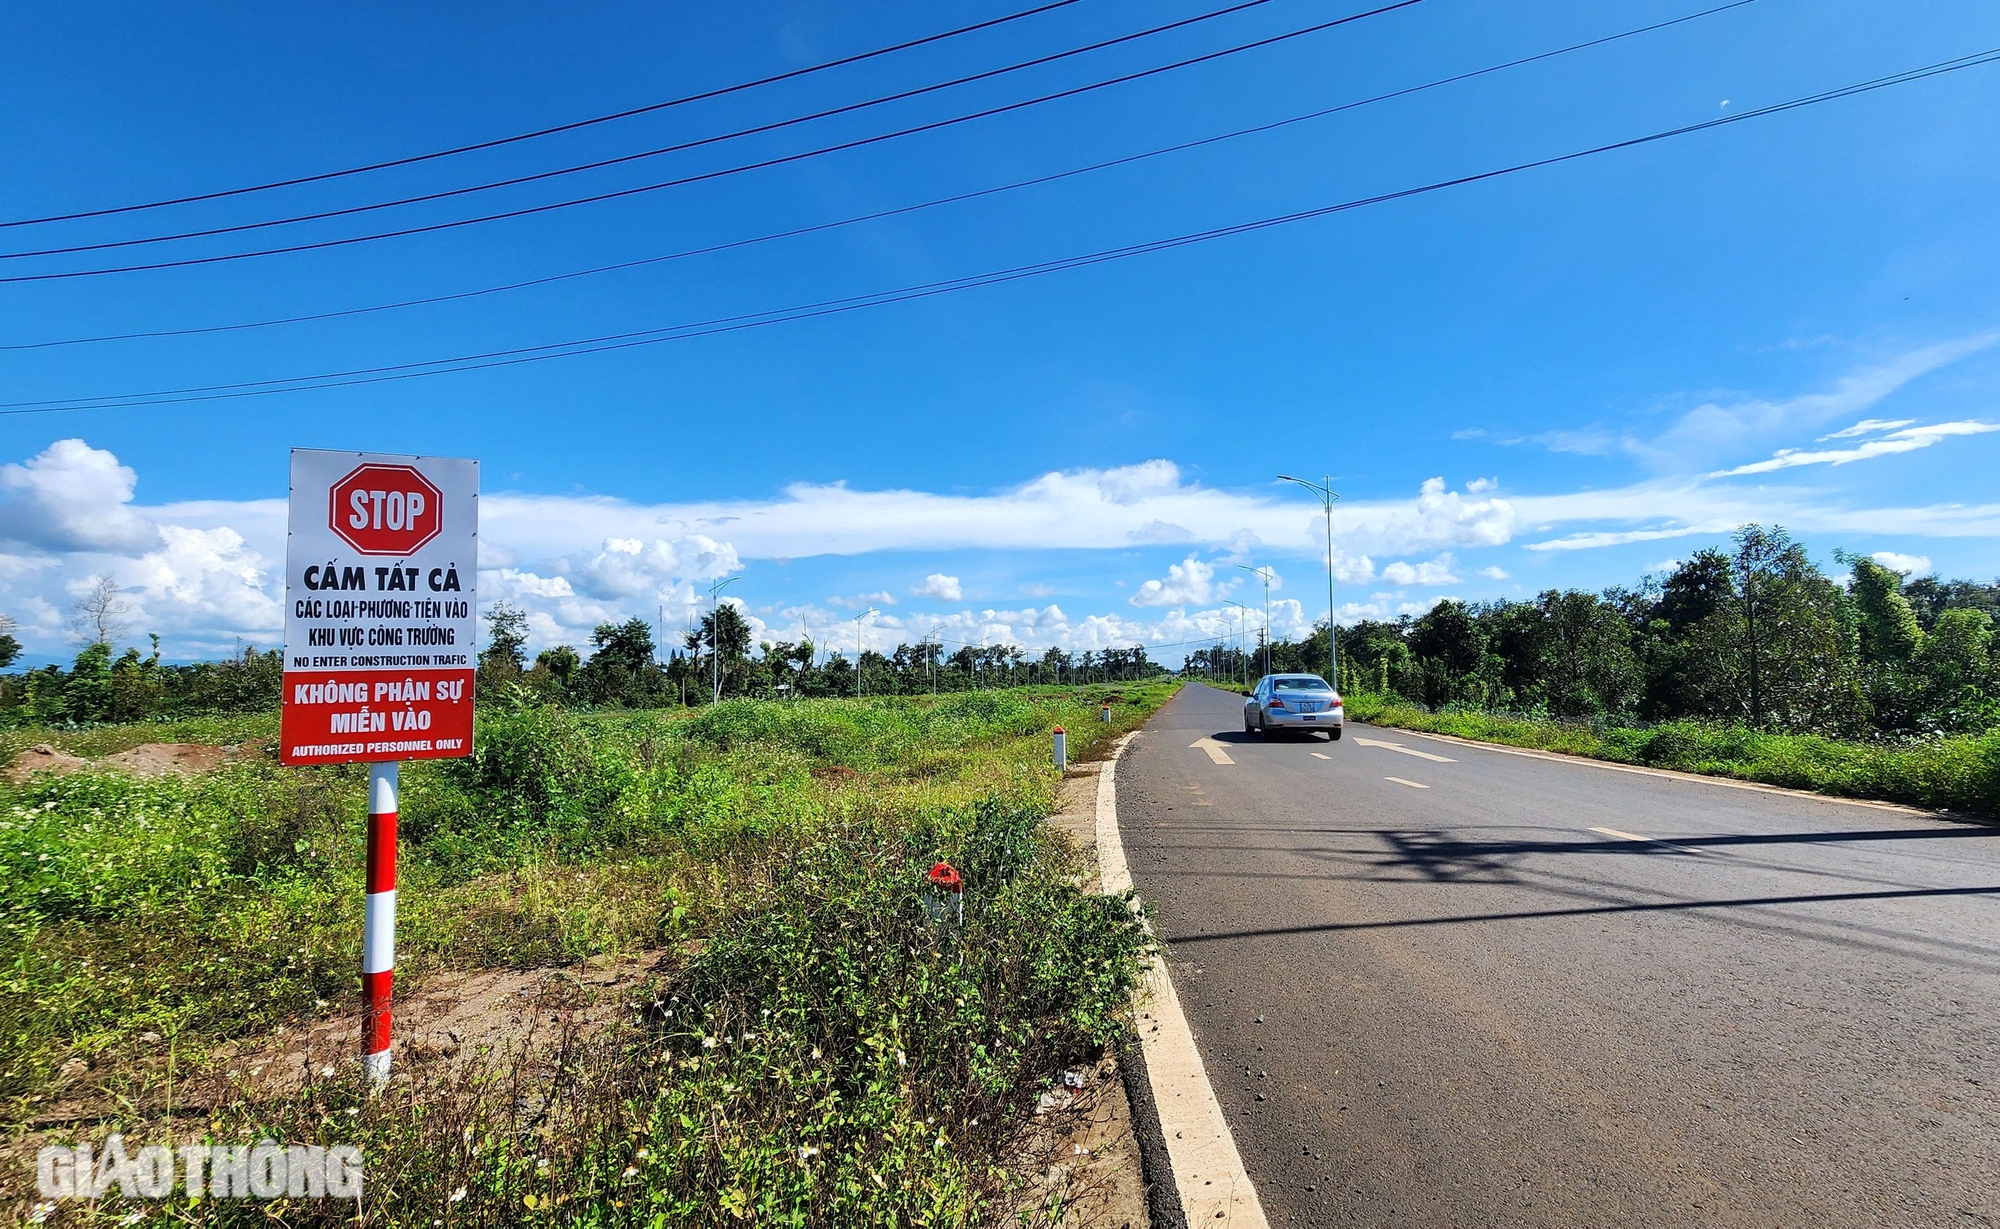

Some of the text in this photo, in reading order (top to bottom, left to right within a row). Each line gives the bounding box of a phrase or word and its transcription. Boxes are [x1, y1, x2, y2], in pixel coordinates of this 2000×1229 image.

[349, 489, 425, 531] STOP
[304, 558, 461, 592] CẤM TẤT CẢ
[296, 596, 467, 622] CÁC LOẠI PHƯƠNG TIỆN VÀO
[309, 624, 455, 650] KHU VỰC CÔNG TRƯỜNG
[294, 655, 467, 667] NO ENTER CONSTRUCTION TRAFIC
[294, 678, 464, 705] KHÔNG PHẬN SỰ
[331, 706, 431, 733] MIỄN VÀO
[292, 739, 462, 757] AUTHORIZED PERSONNEL ONLY
